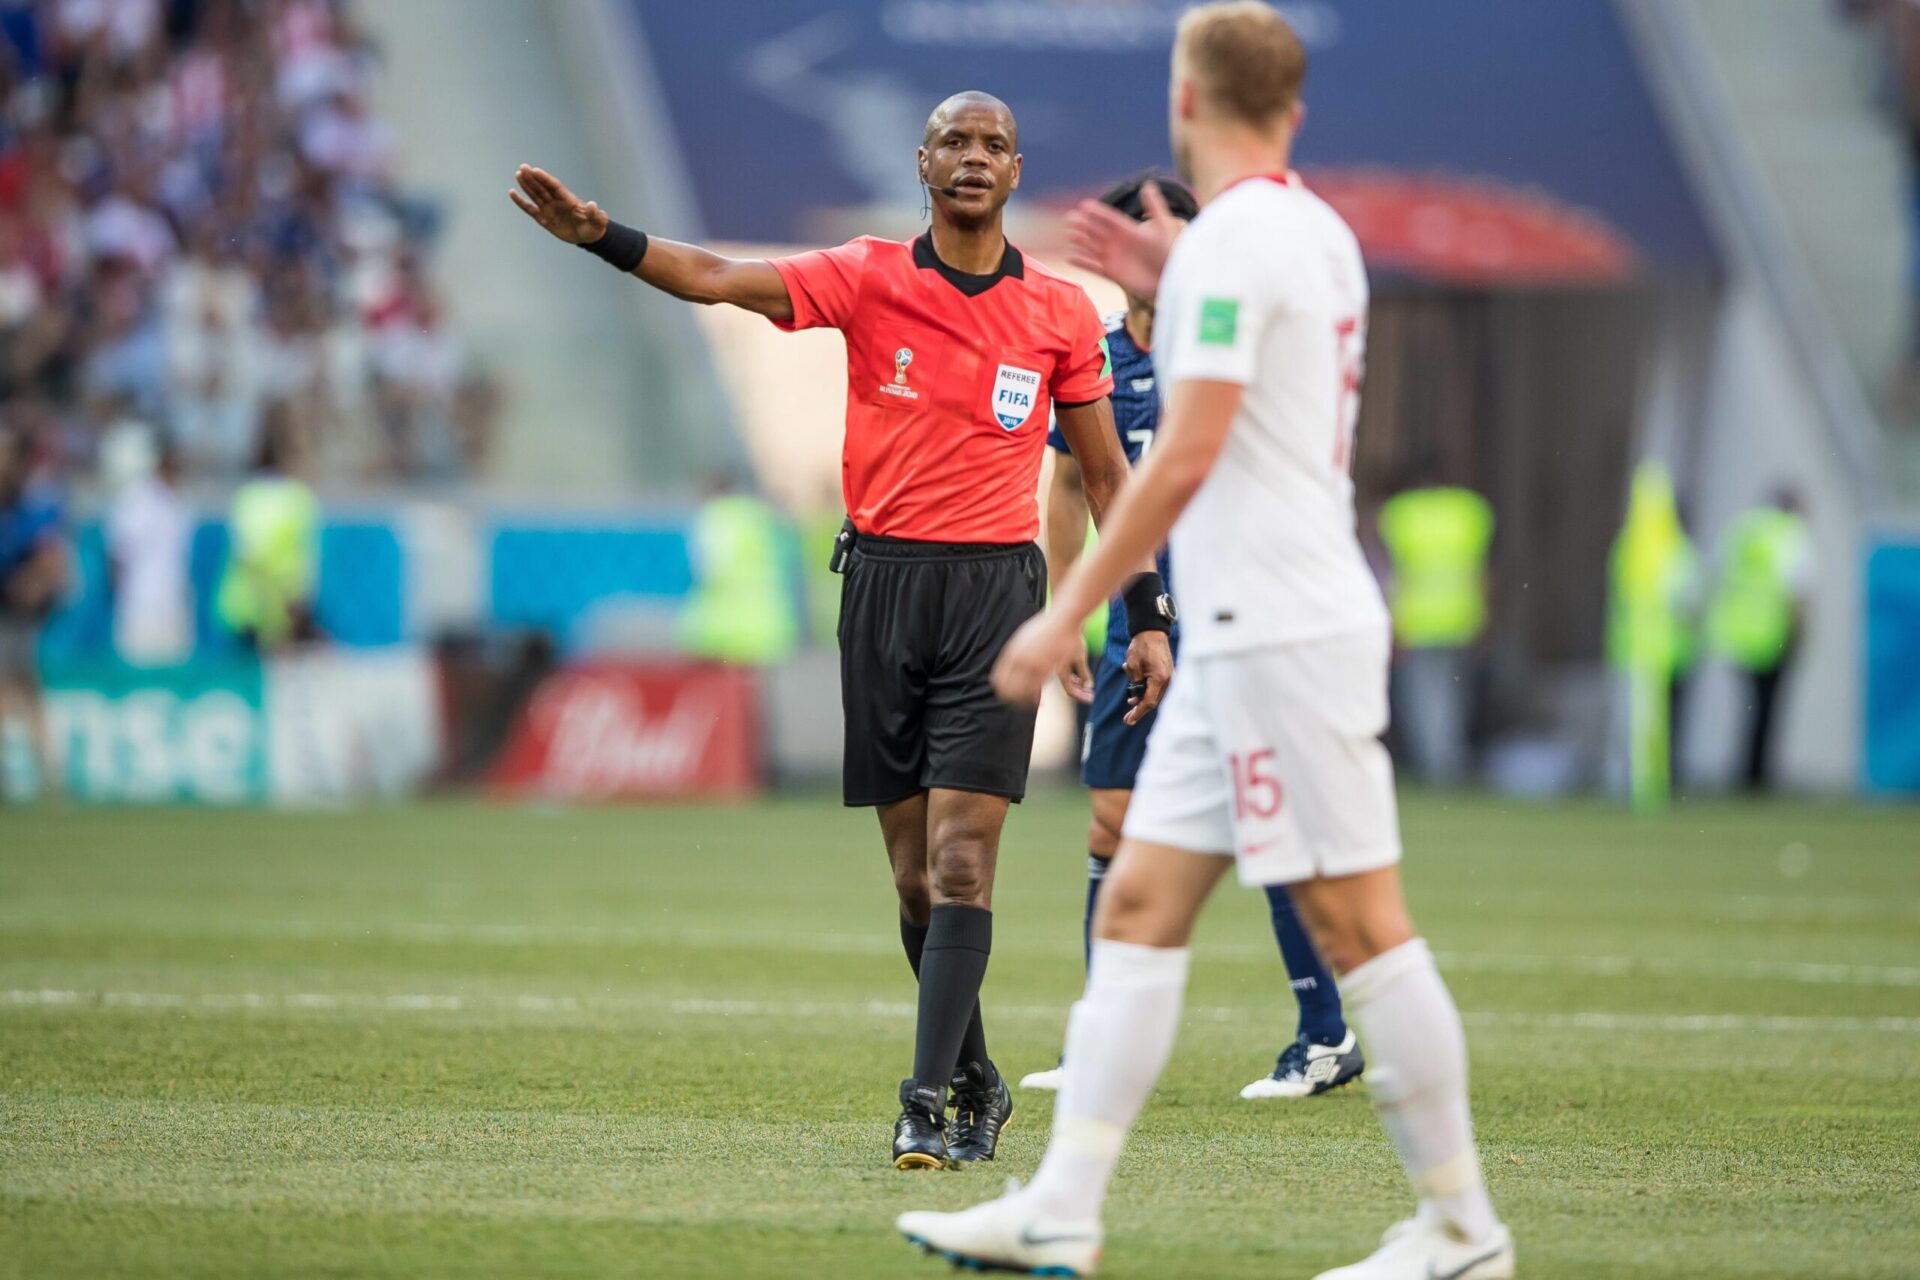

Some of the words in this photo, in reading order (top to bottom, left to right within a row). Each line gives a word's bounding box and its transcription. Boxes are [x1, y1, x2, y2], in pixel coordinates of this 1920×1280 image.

[1000, 370, 1036, 385] REFEREE
[998, 389, 1029, 407] FIFA
[1127, 429, 1154, 461] 7
[1228, 747, 1284, 822] 15
